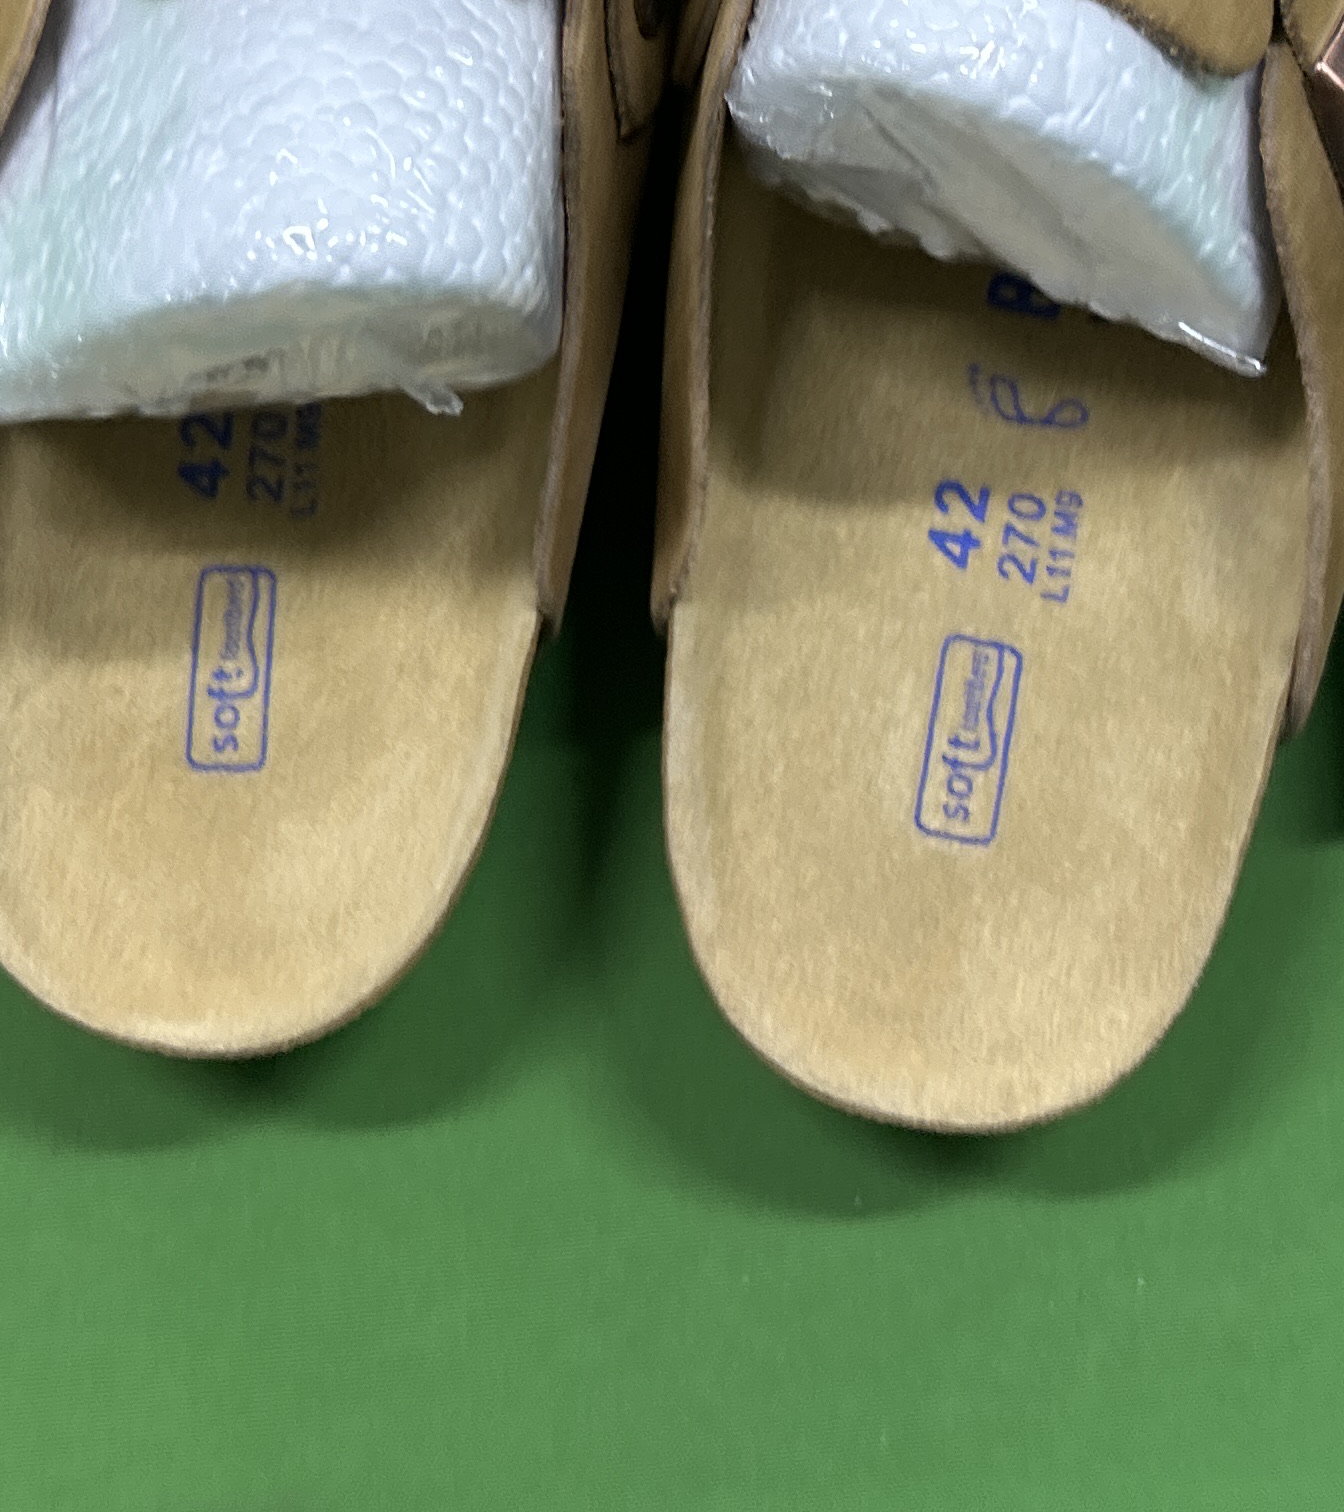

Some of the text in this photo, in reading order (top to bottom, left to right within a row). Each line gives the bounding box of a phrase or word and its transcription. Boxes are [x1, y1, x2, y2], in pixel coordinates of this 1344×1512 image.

[178, 412, 234, 502] 42
[246, 412, 289, 503] 270
[928, 479, 991, 571] 42
[997, 491, 1047, 585] 270
[207, 665, 244, 753] soft
[942, 734, 980, 823] soft
